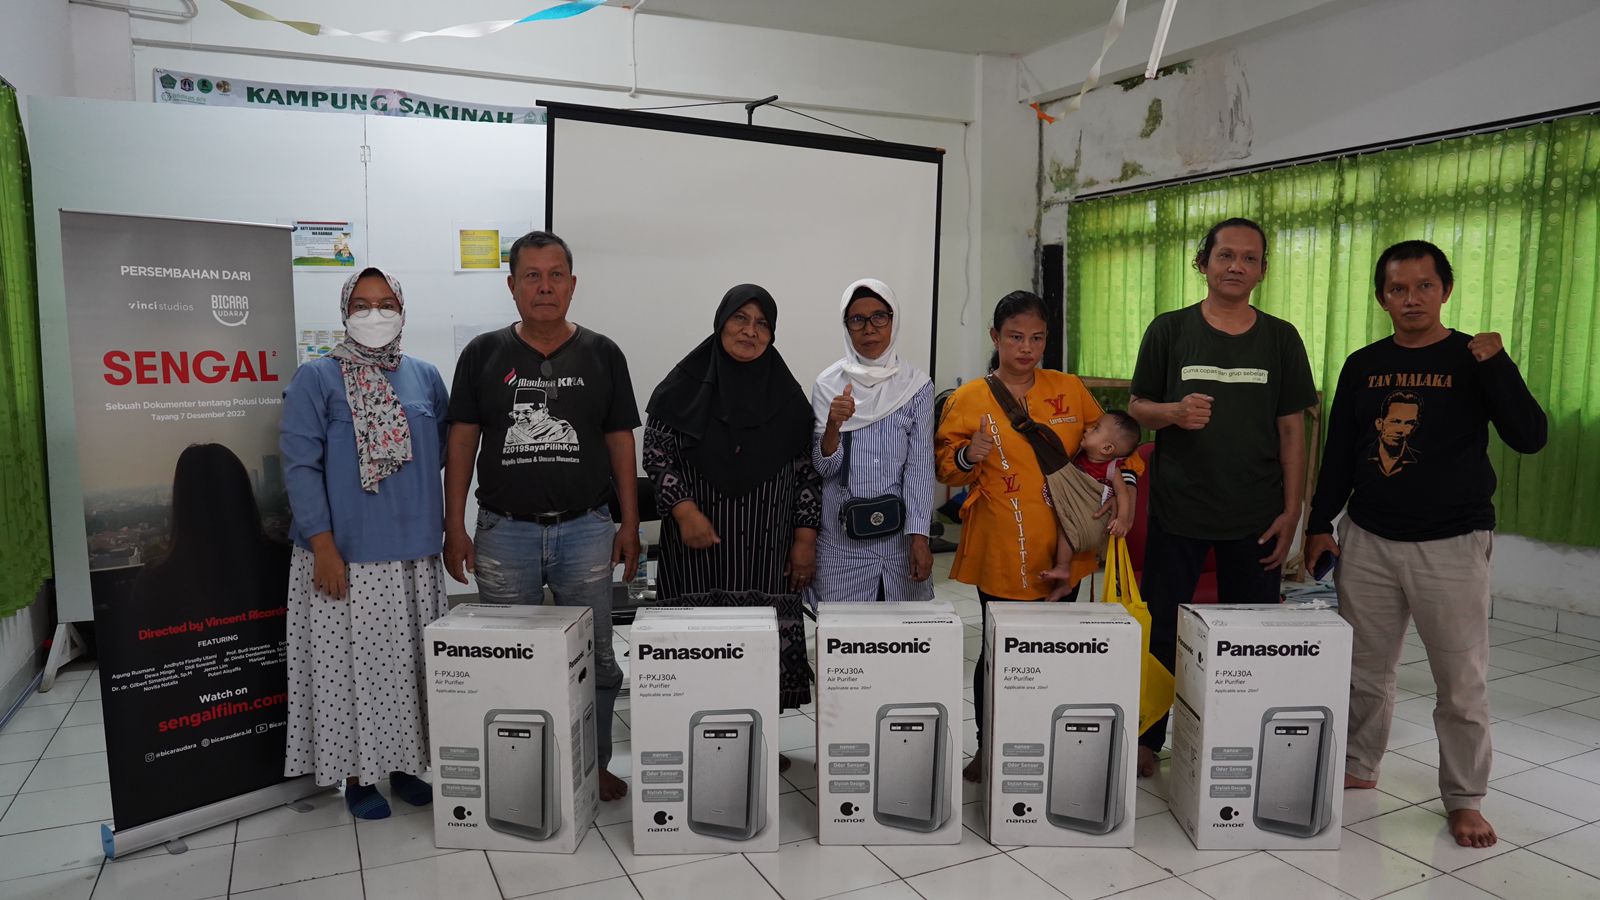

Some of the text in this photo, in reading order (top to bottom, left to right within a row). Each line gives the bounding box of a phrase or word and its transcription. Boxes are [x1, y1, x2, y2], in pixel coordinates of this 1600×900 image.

[246, 86, 514, 124] KAMPUNG SAKINAH
[120, 265, 251, 281] PERSEMBAHAN DARI
[211, 294, 249, 309] BICARA
[103, 350, 279, 385] SENGAL
[1367, 373, 1453, 388] TAN MALAKA
[105, 397, 281, 411] Sebuah Dokumenter tentang Polusi Udara
[151, 413, 179, 421] Tayang
[186, 411, 225, 420] Desember
[227, 410, 246, 418] 2022
[502, 443, 580, 454] #2019SayaPilihKyai
[138, 622, 187, 641] Directed
[188, 620, 204, 632] by
[205, 612, 247, 628] Vincent
[197, 634, 239, 648] FEATURING
[827, 638, 931, 654] Panasonic
[1004, 637, 1109, 654] Panasonic
[1216, 640, 1320, 657] Panasonic
[433, 641, 534, 660] Panasonic
[638, 643, 744, 660] Panasonic
[112, 672, 131, 680] Agung
[434, 670, 471, 678] F-PXJ30A
[827, 667, 864, 675] F-PXJ30A
[199, 687, 248, 704] Watch on
[158, 692, 288, 733] sengalfilm.com
[210, 729, 252, 744] bicaraudara.id
